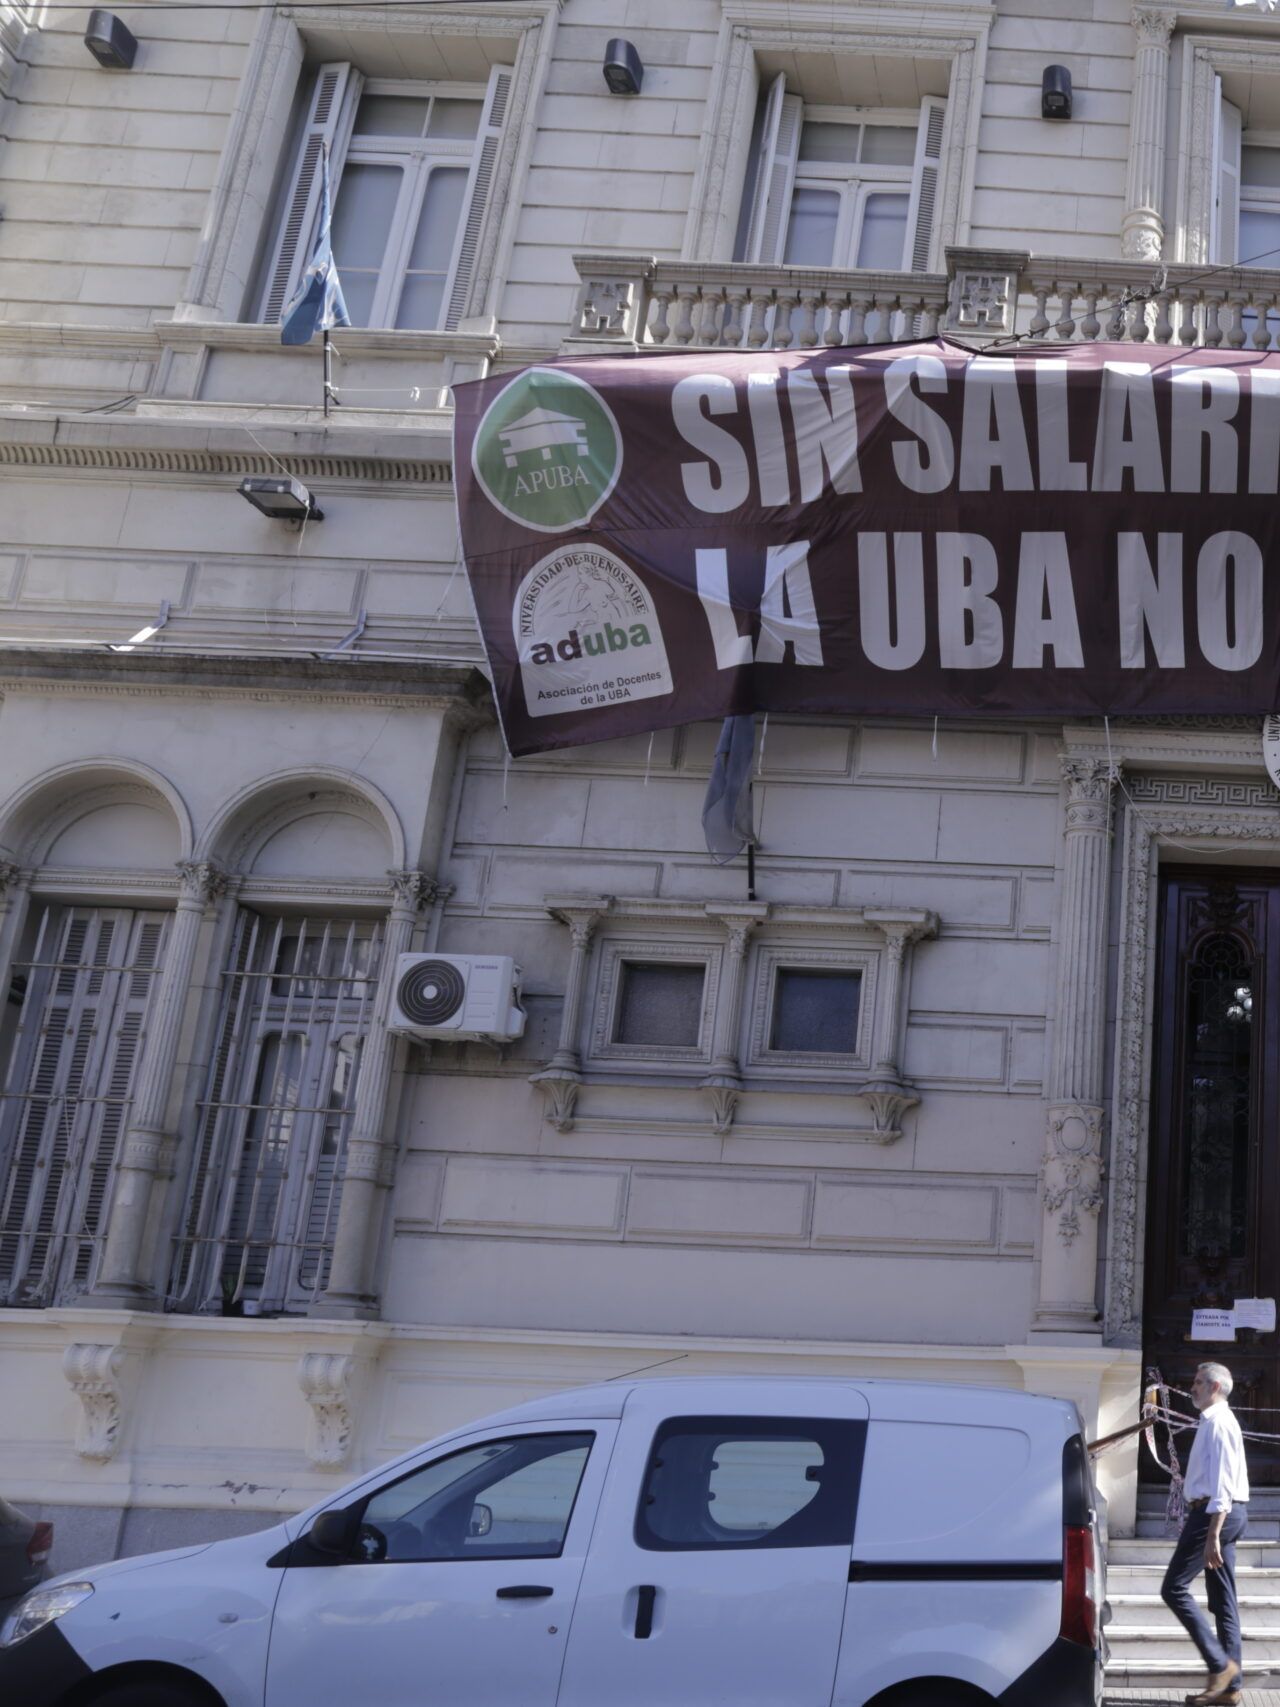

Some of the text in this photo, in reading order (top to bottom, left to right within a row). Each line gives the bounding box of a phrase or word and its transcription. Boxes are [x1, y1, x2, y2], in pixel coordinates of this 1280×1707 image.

[671, 366, 864, 513] SIN
[514, 464, 591, 497] APUBA
[695, 540, 824, 670] LA
[857, 531, 1085, 671] UBA
[1117, 530, 1264, 672] NO
[530, 622, 652, 666] aduba
[538, 671, 662, 699] Asociación de Docentes
[580, 687, 631, 706] de la UBA
